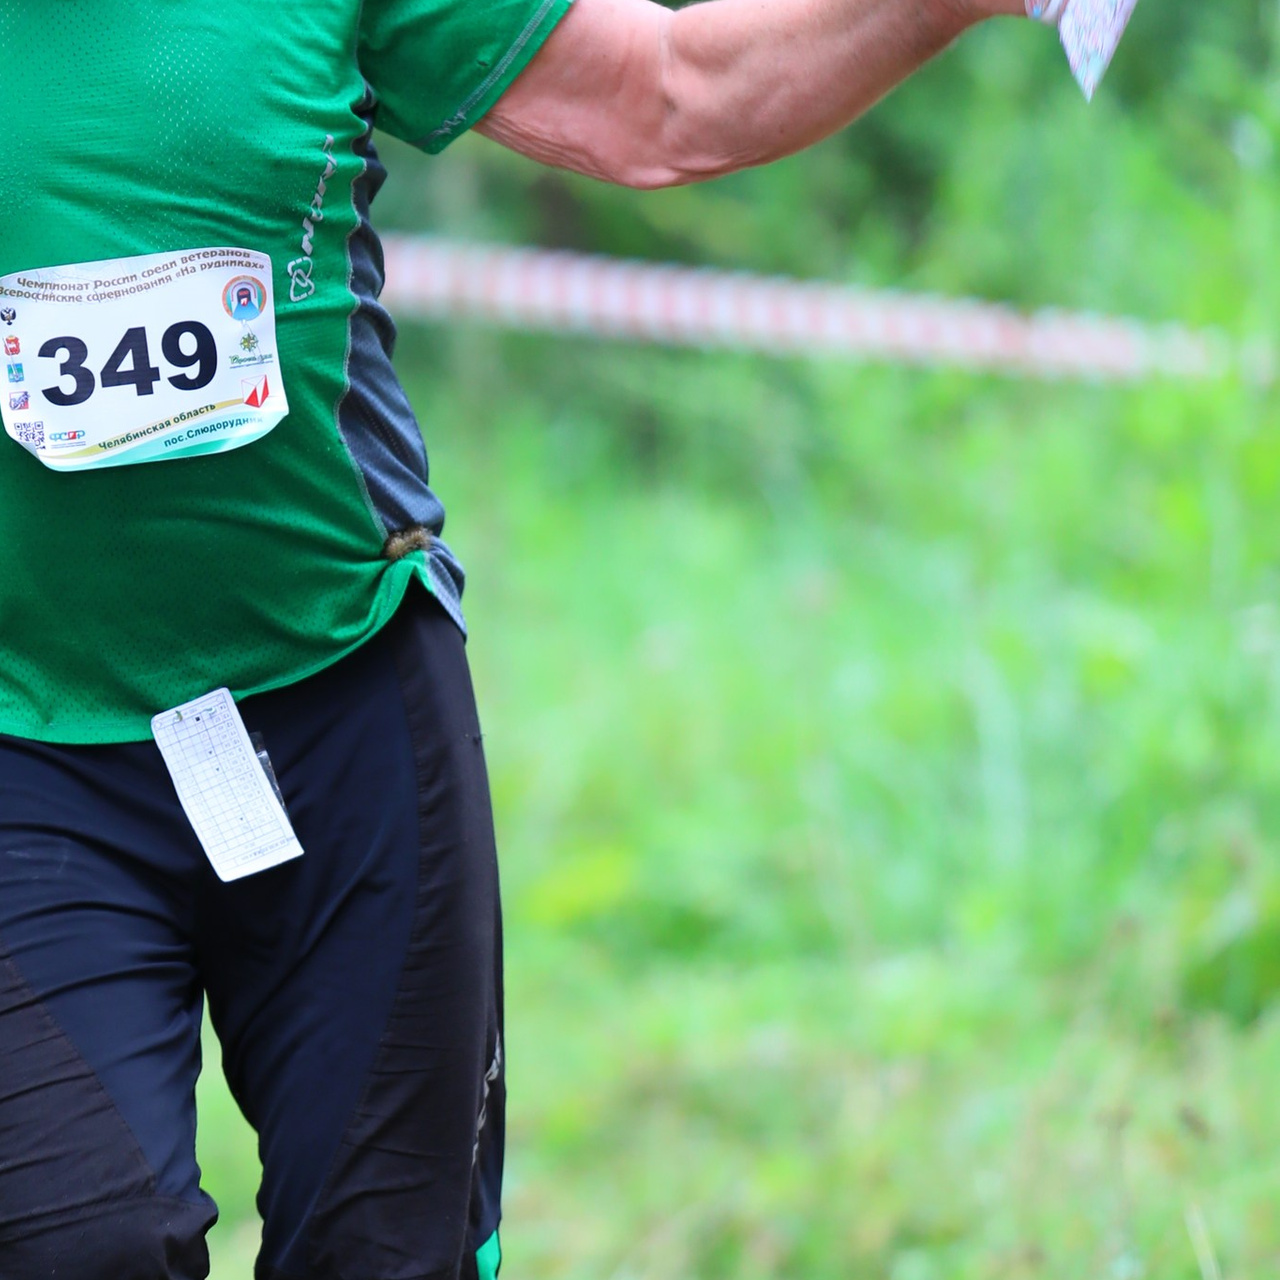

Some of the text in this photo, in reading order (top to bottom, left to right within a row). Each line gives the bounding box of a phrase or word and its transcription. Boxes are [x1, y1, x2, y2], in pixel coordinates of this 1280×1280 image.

[17, 249, 251, 291] Чемпионат России среди ветеранов
[86, 274, 173, 302] соревнования
[37, 320, 218, 407] 349
[98, 404, 217, 451] Челябинская область
